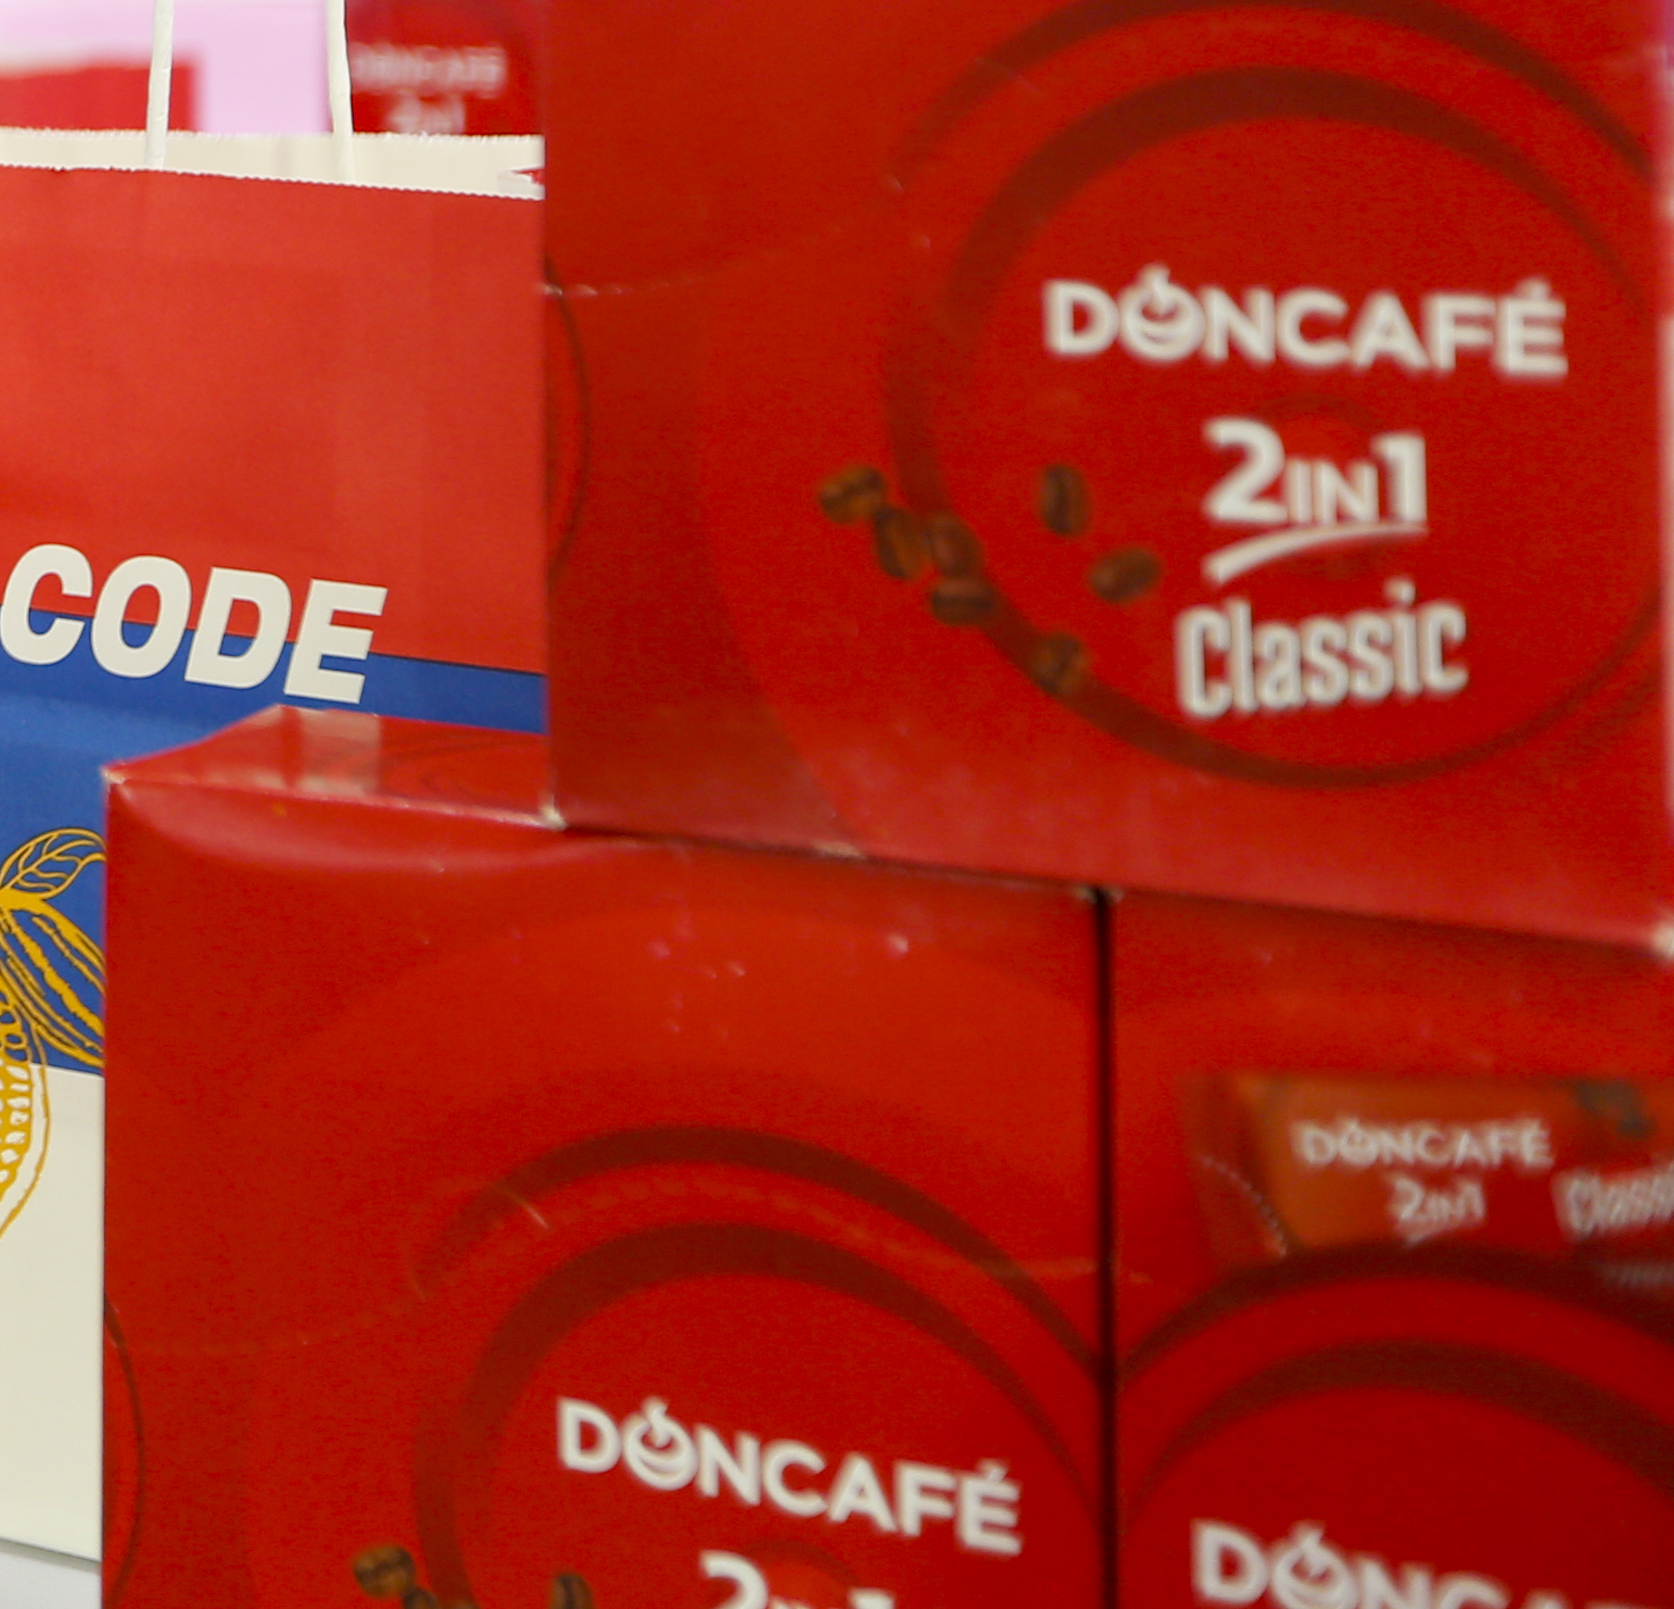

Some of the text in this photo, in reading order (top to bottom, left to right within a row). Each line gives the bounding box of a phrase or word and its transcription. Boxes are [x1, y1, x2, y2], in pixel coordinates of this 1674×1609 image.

[1045, 263, 1568, 377] DONCAFÉ
[1176, 575, 1468, 718] Classic
[1293, 1115, 1554, 1169] DONCAFÉ
[558, 1396, 1021, 1556] DONCAFÉ
